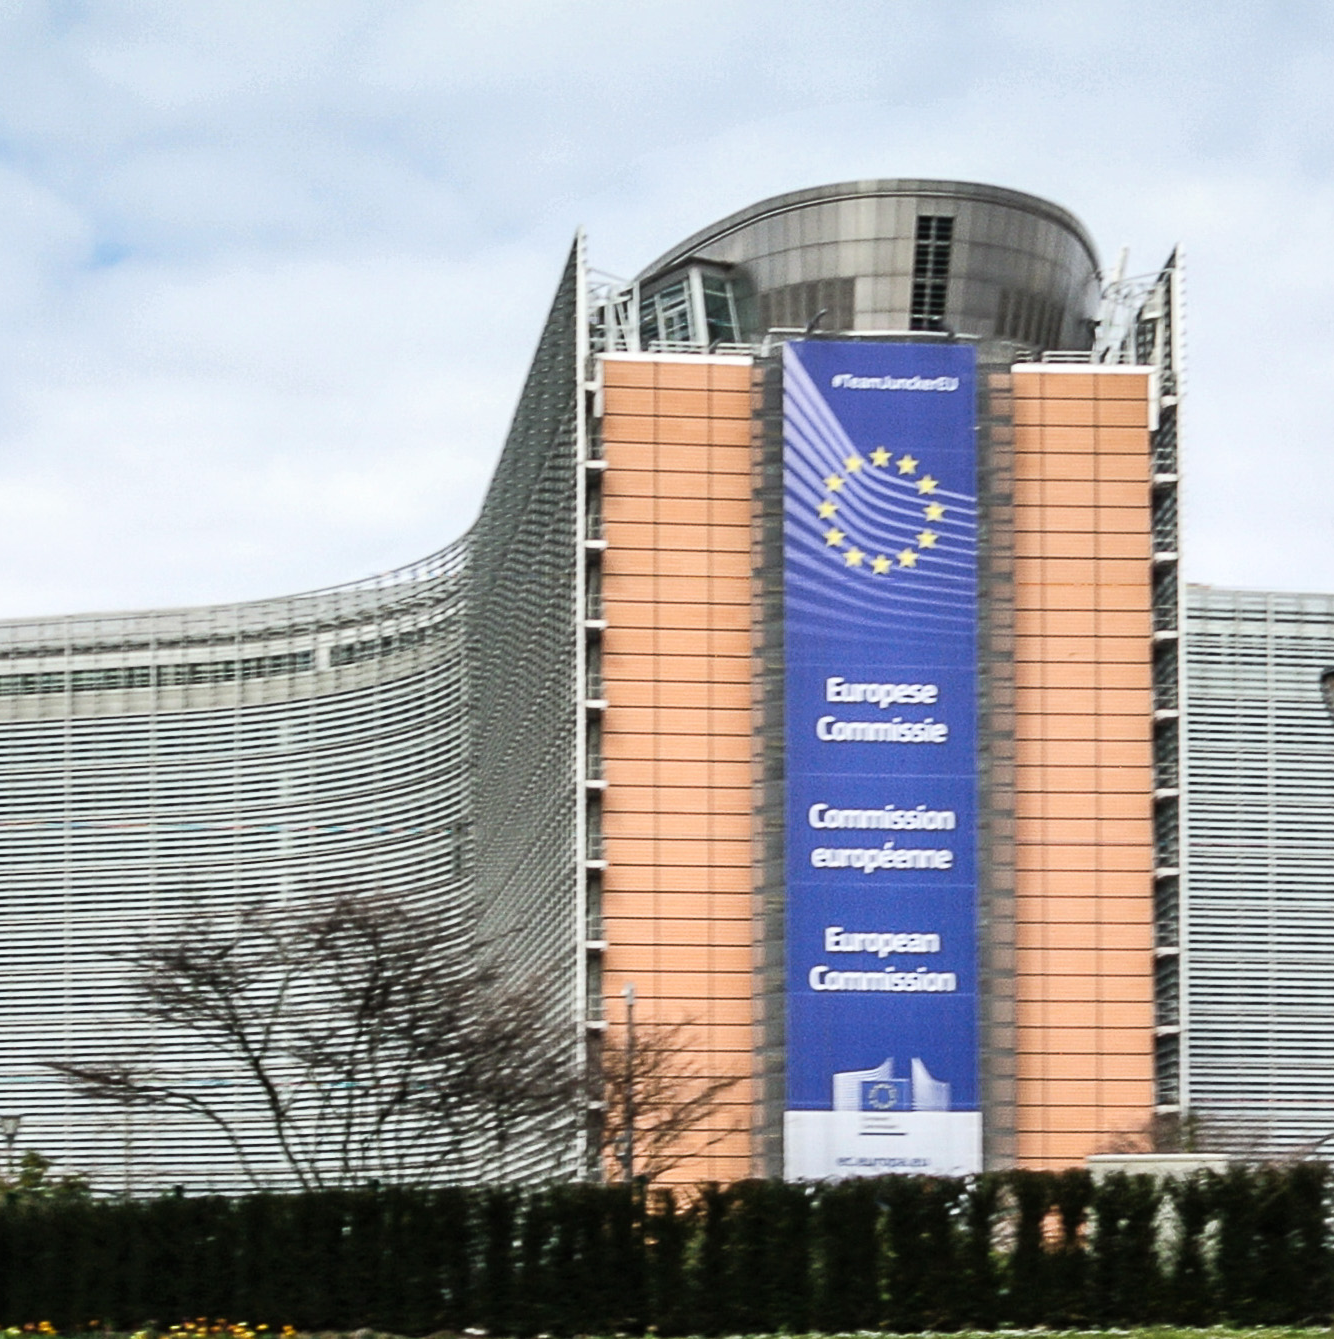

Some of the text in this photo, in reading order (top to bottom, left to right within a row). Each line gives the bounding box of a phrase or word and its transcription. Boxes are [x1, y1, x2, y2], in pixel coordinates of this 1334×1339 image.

[832, 374, 959, 391] #TeamJunckerEU
[826, 677, 938, 708] Europese
[817, 716, 948, 743] Commissie
[809, 803, 956, 829] Commission
[811, 841, 953, 873] européenne
[825, 927, 940, 957] European
[809, 966, 957, 991] Commission
